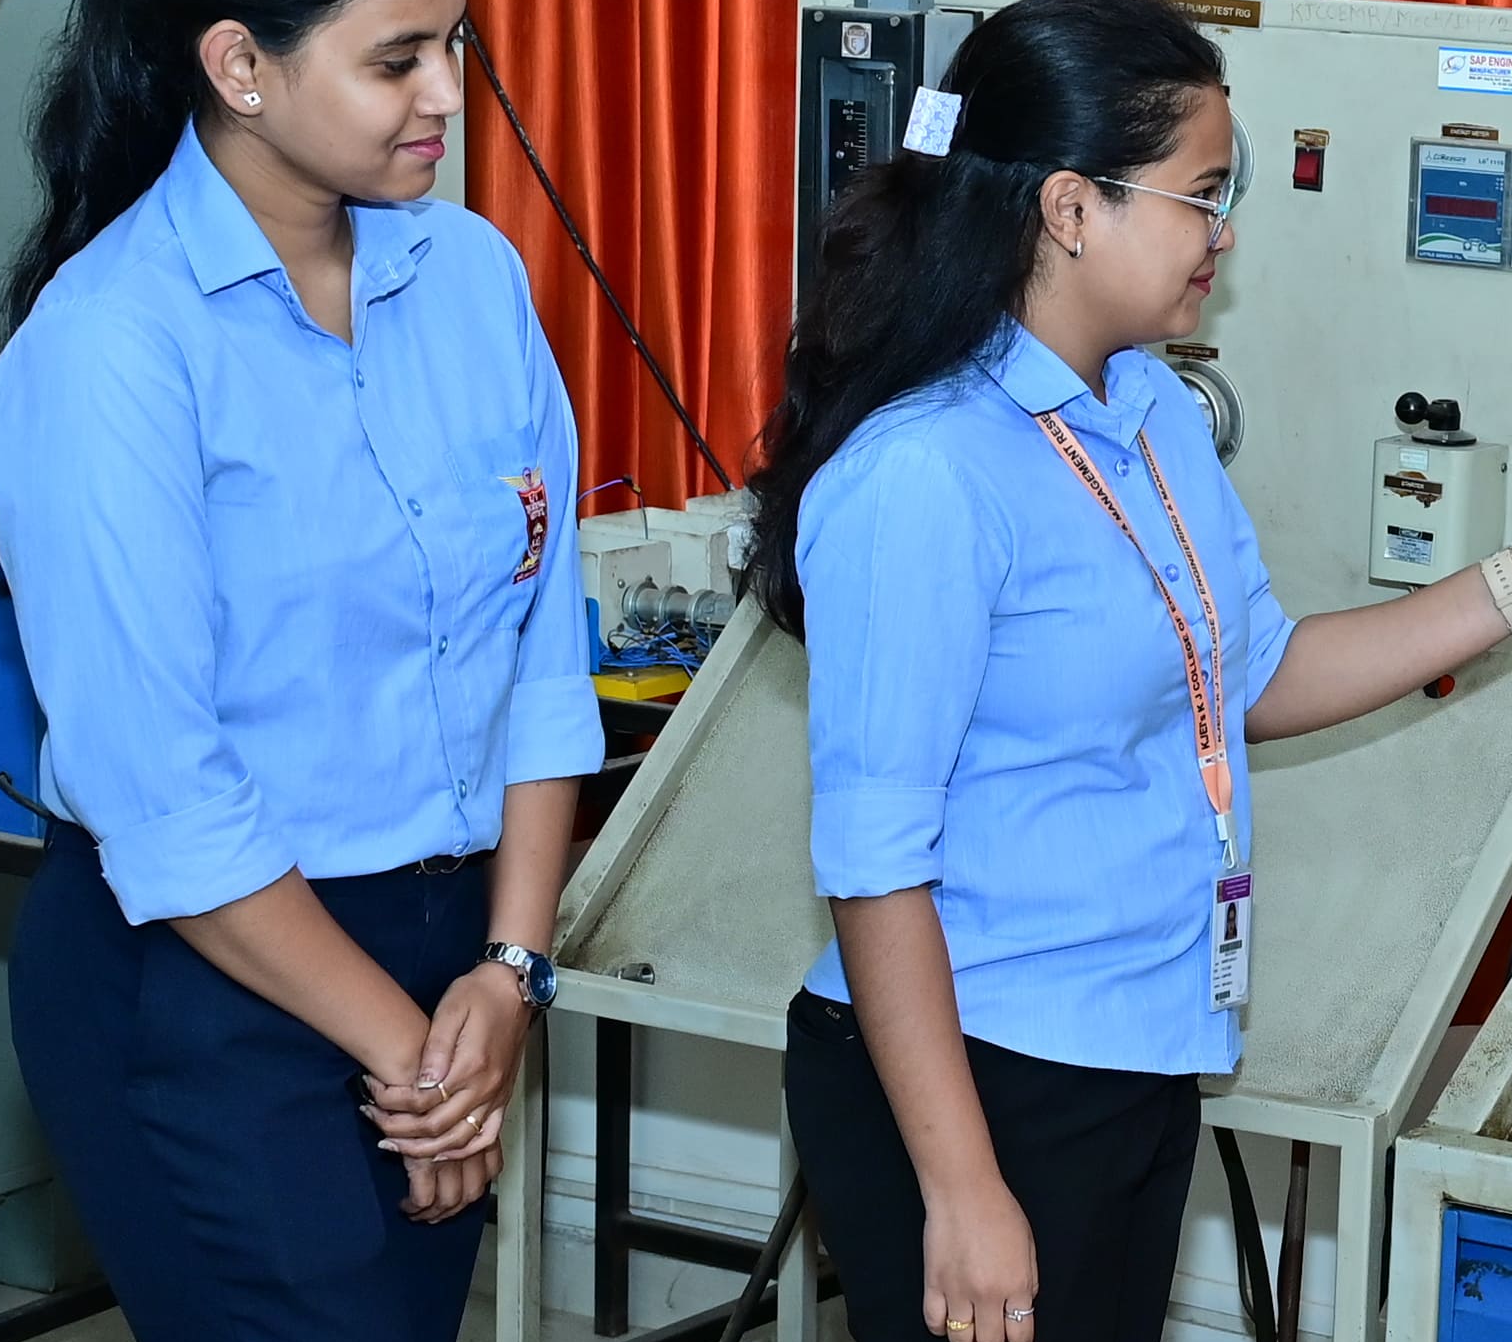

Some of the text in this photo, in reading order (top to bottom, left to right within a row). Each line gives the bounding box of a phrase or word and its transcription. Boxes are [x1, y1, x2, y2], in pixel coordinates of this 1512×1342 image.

[1186, 3, 1212, 13] PUMP
[1212, 6, 1234, 17] TEST
[1235, 8, 1252, 19] RIG
[1469, 67, 1512, 75] MANUFACTURER
[1470, 55, 1486, 65] SAP
[1041, 413, 1068, 445] RESE
[1063, 444, 1122, 523] MANAGEMENT
[1139, 434, 1168, 503] MANAGEME
[1170, 514, 1210, 597] ENGINEERING
[1184, 629, 1200, 691] COLLEGE
